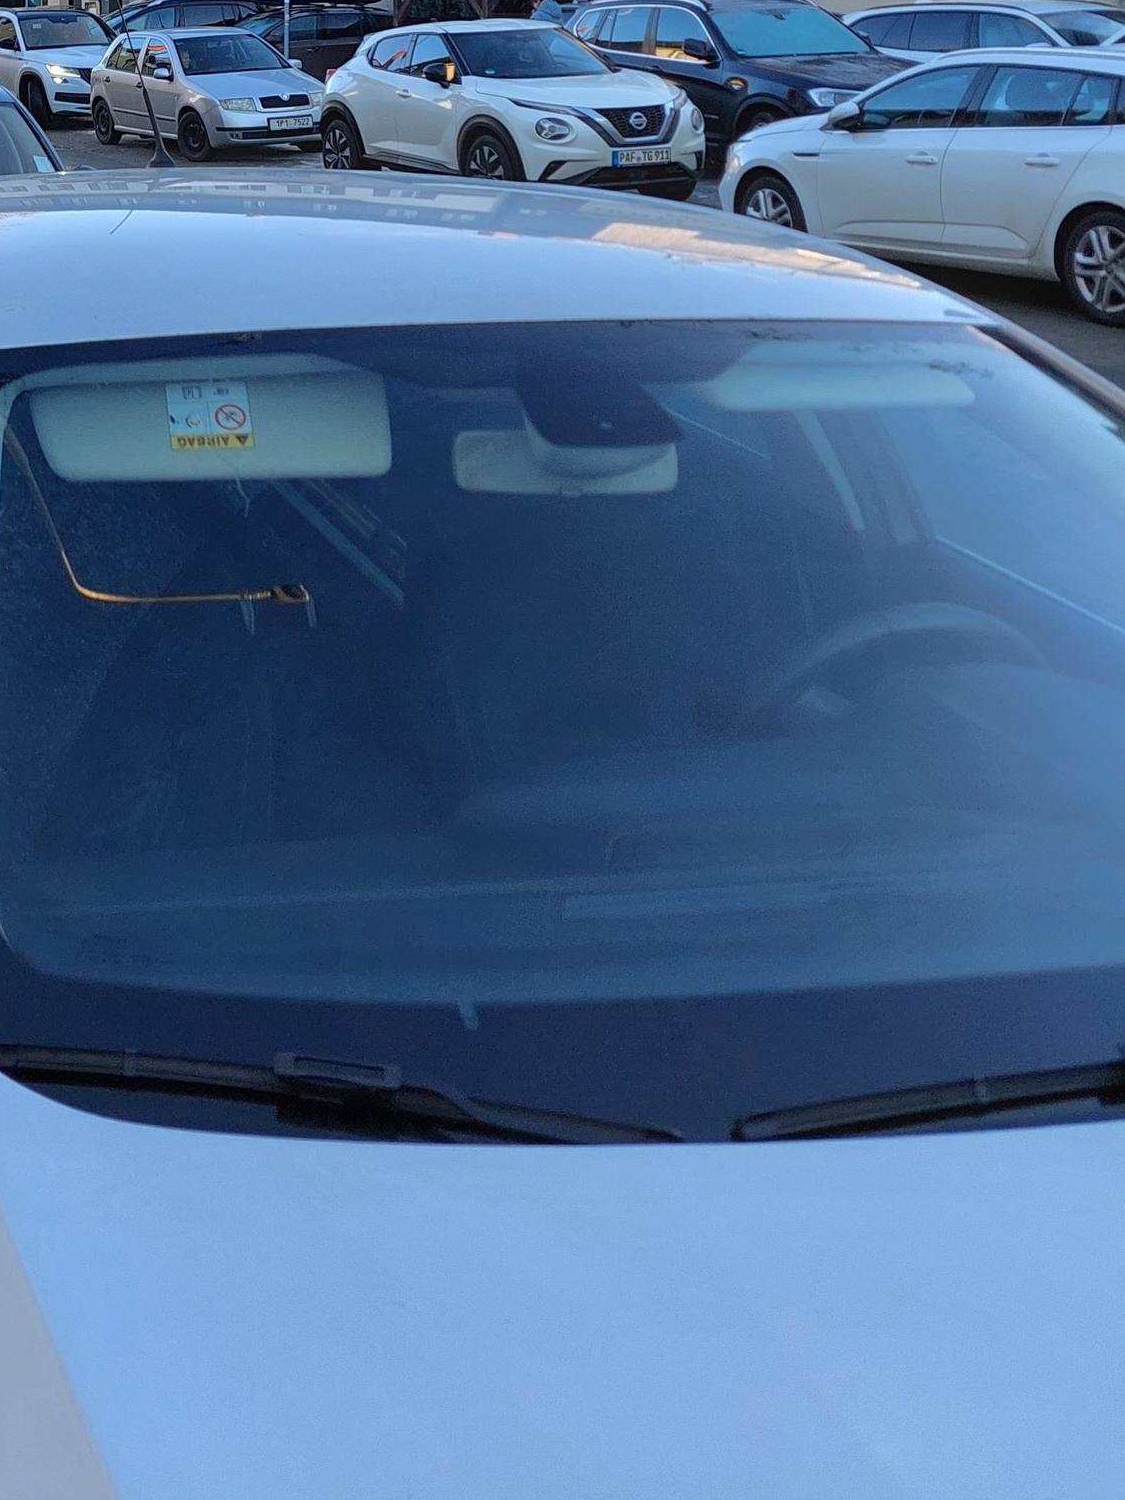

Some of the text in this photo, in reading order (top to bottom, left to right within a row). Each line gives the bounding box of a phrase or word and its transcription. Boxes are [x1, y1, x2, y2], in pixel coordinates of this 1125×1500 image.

[619, 150, 669, 162] PAF TG 911
